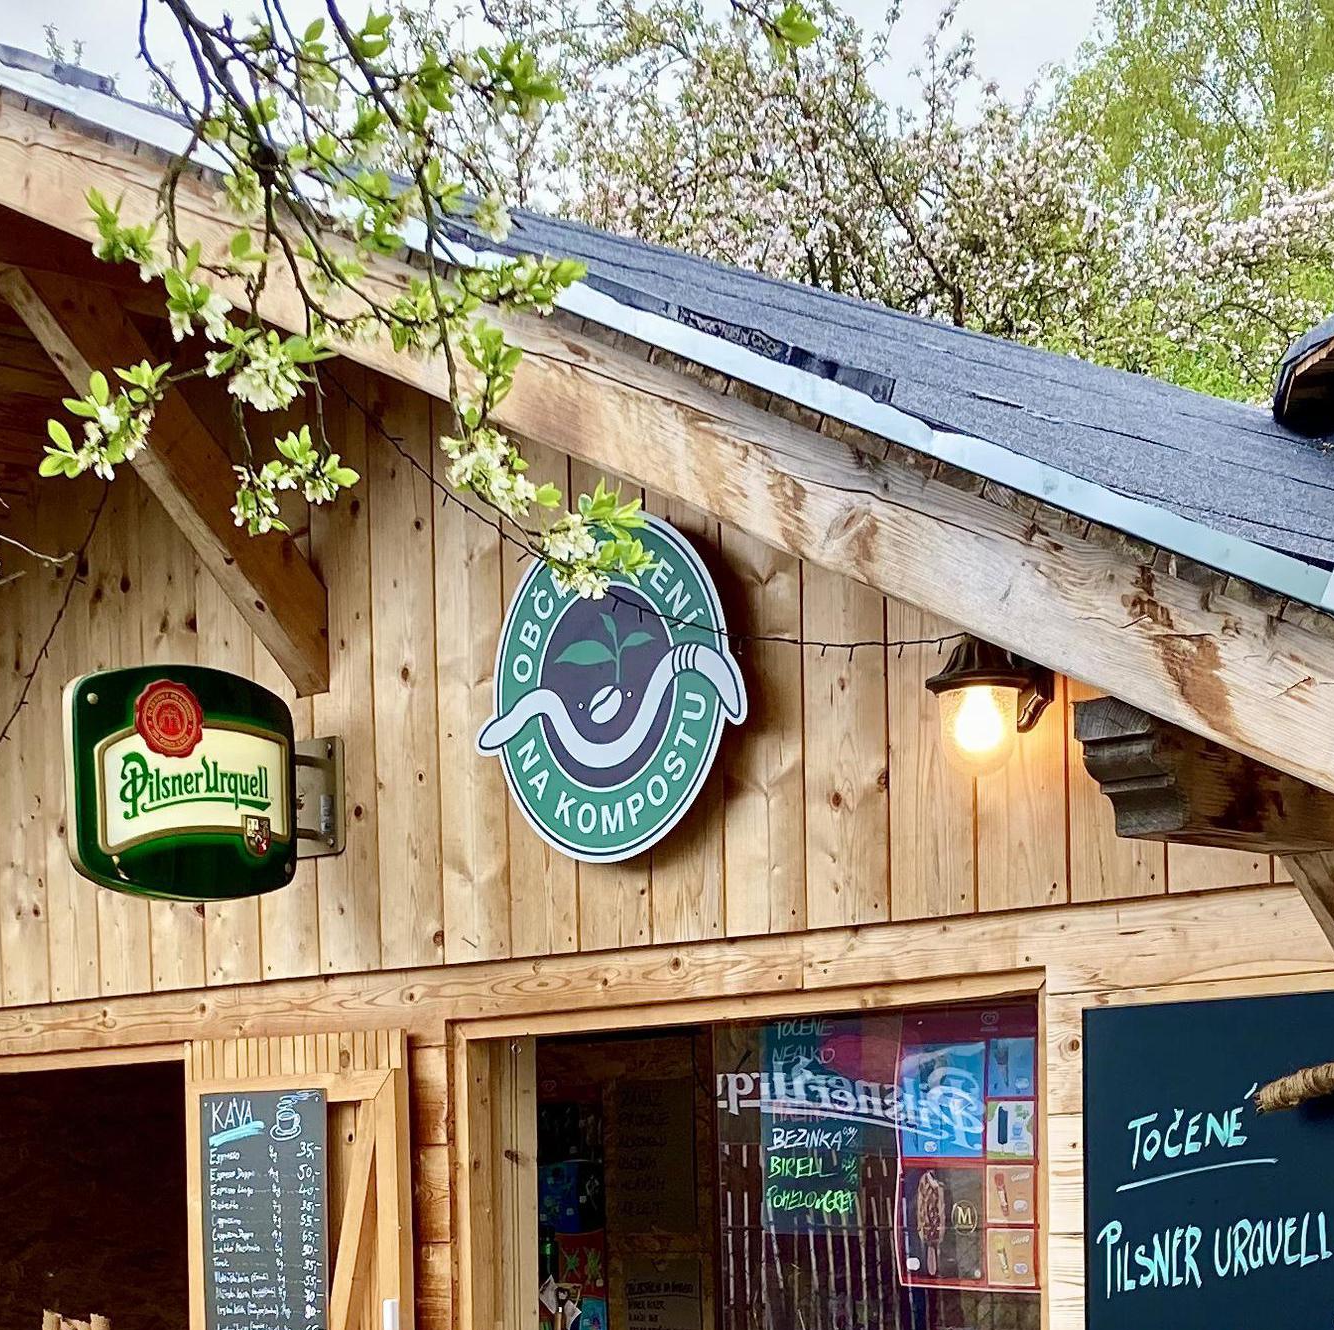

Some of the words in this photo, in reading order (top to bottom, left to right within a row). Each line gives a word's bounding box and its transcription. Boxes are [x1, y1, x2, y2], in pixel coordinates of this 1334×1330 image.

[120, 751, 203, 820] Pilsner
[201, 755, 269, 810] Urquell
[515, 743, 557, 802] NA
[555, 690, 708, 835] KOMPOSTU
[767, 1127, 842, 1151] BEZINKA
[1128, 1083, 1258, 1170] TOČENÉ
[1097, 1220, 1202, 1298] PILSNER
[1213, 1211, 1332, 1278] URQUELL
